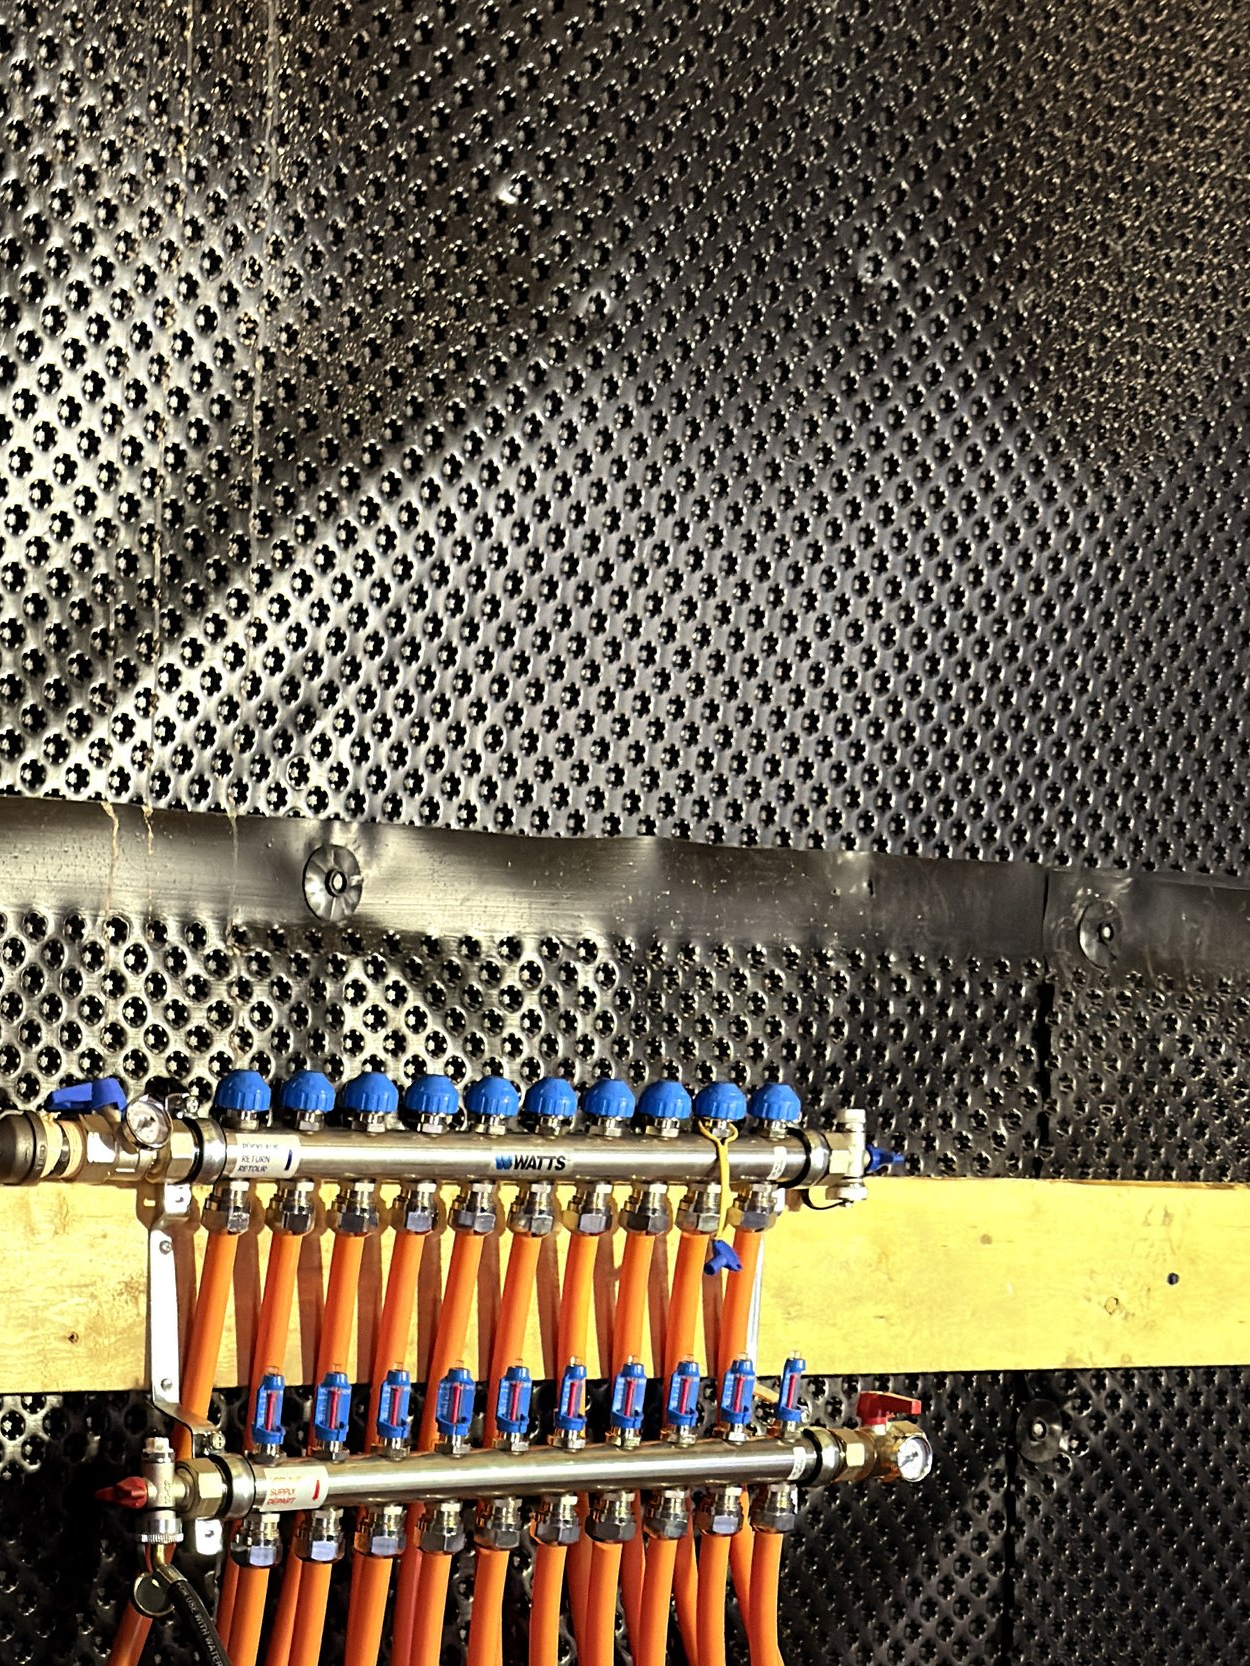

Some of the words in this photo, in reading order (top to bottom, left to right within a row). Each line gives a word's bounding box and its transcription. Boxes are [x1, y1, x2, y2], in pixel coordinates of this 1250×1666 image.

[242, 1155, 270, 1164] RETURN
[513, 1155, 566, 1171] WATTS
[186, 1597, 198, 1612] USE
[195, 1614, 210, 1636] WITH
